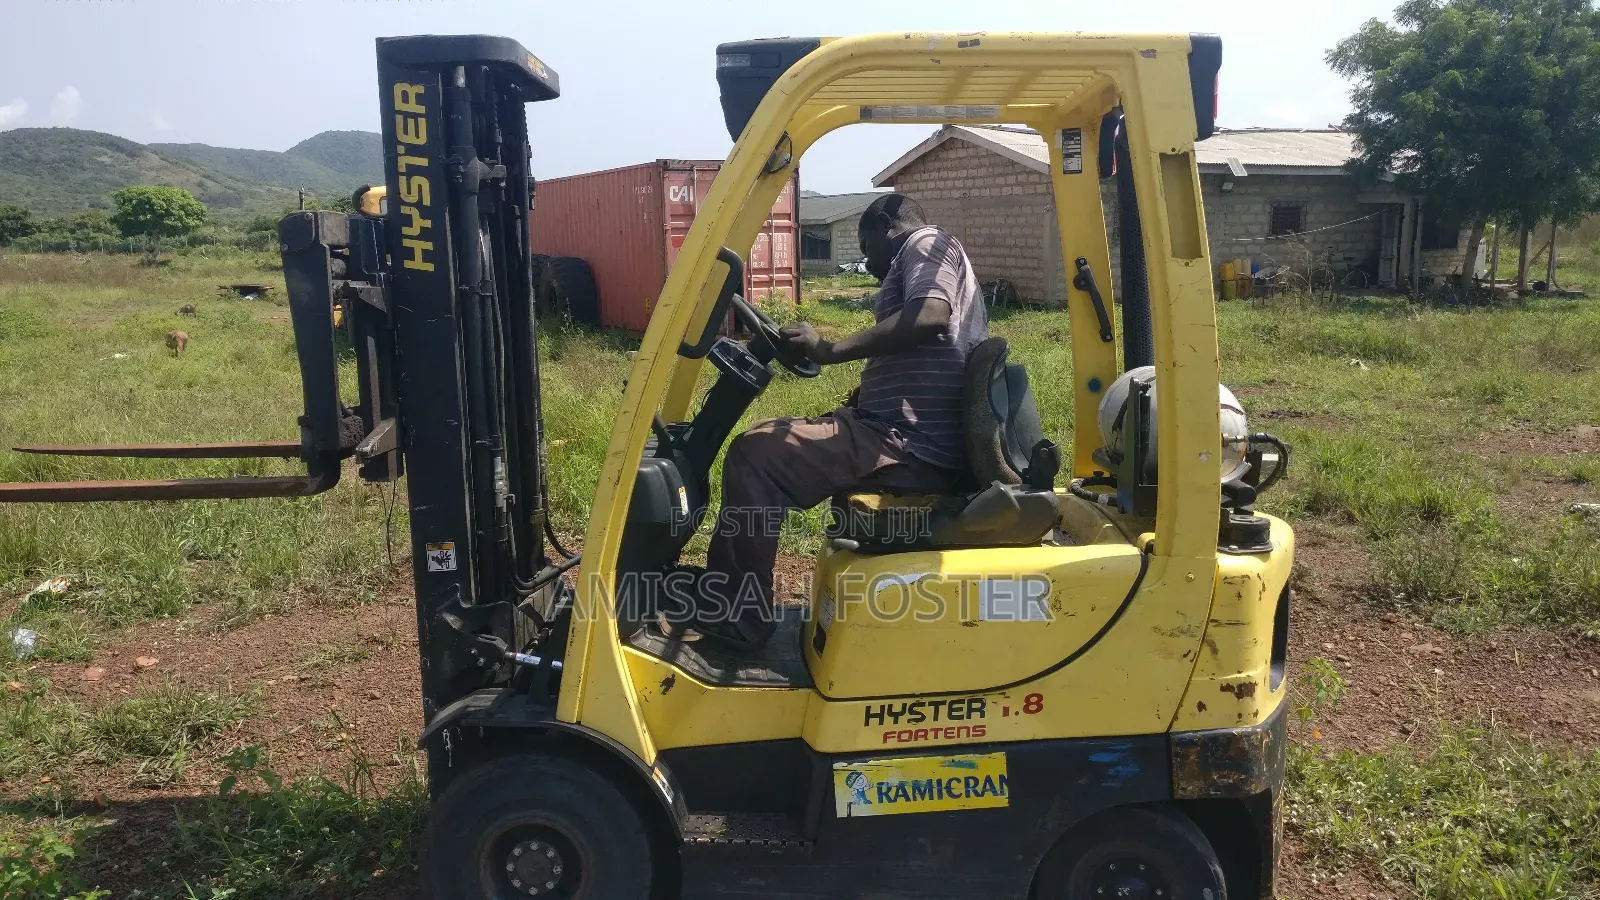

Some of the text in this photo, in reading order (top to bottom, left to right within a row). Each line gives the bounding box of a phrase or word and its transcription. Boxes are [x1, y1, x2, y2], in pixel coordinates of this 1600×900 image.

[393, 82, 435, 272] HYSTER
[669, 185, 694, 202] CAI
[864, 697, 987, 727] HYSTER
[882, 724, 987, 744] FORTENS
